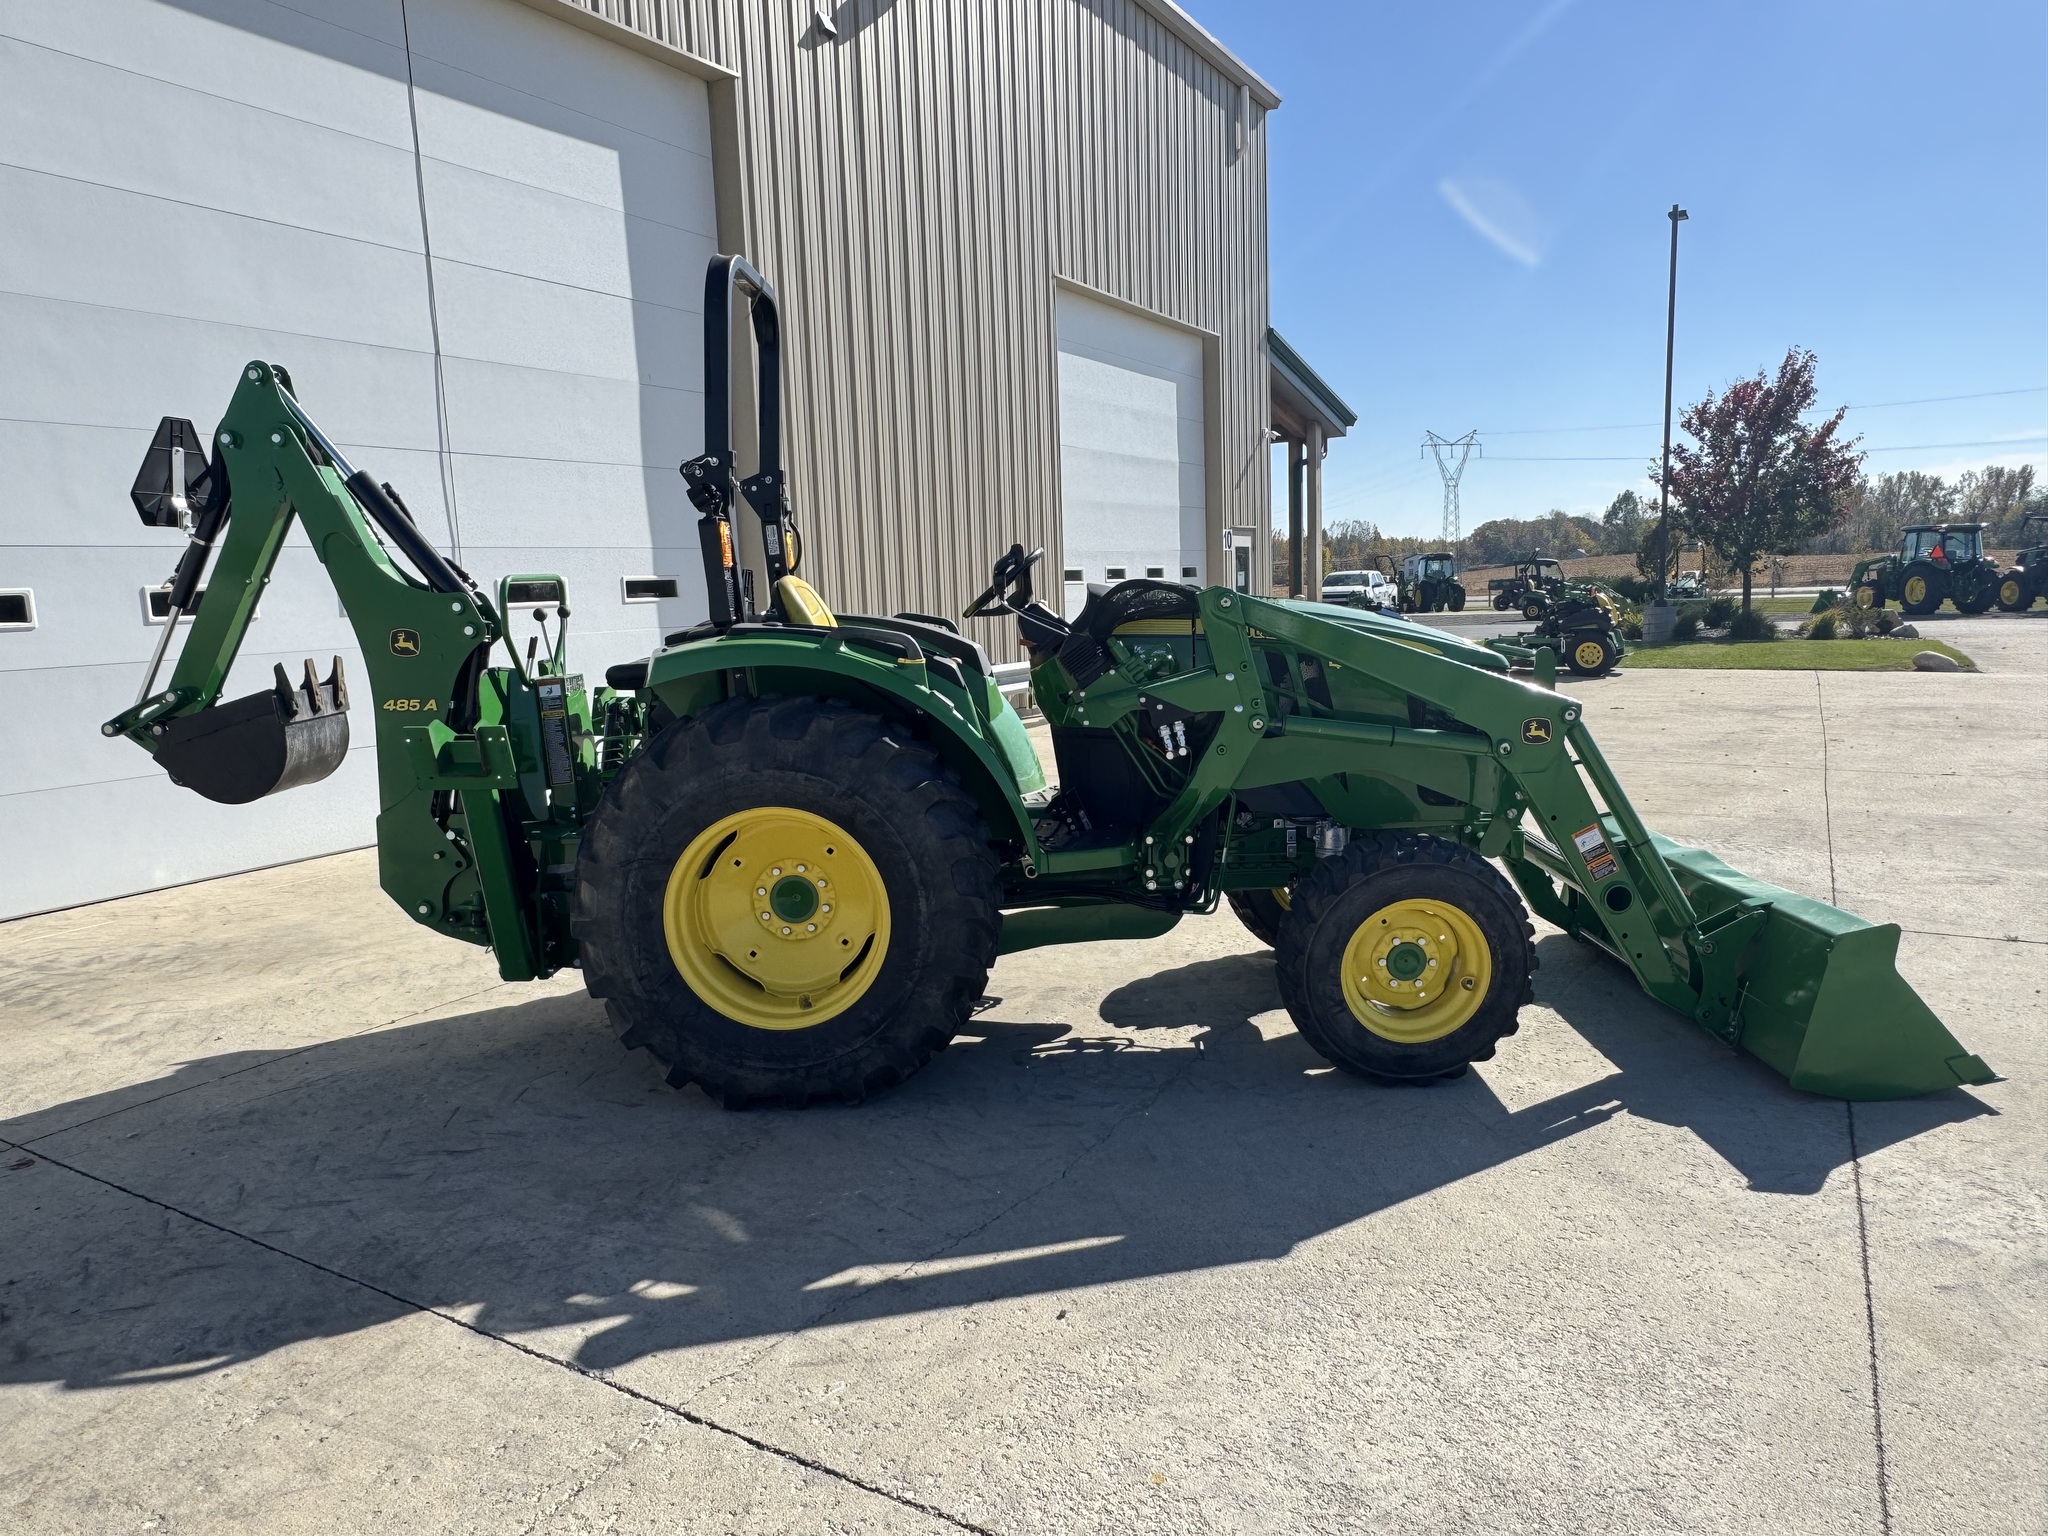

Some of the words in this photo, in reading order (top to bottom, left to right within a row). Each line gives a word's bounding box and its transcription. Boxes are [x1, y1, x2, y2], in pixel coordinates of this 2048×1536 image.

[1224, 530, 1232, 549] 10
[383, 699, 420, 711] 485
[422, 699, 438, 711] A
